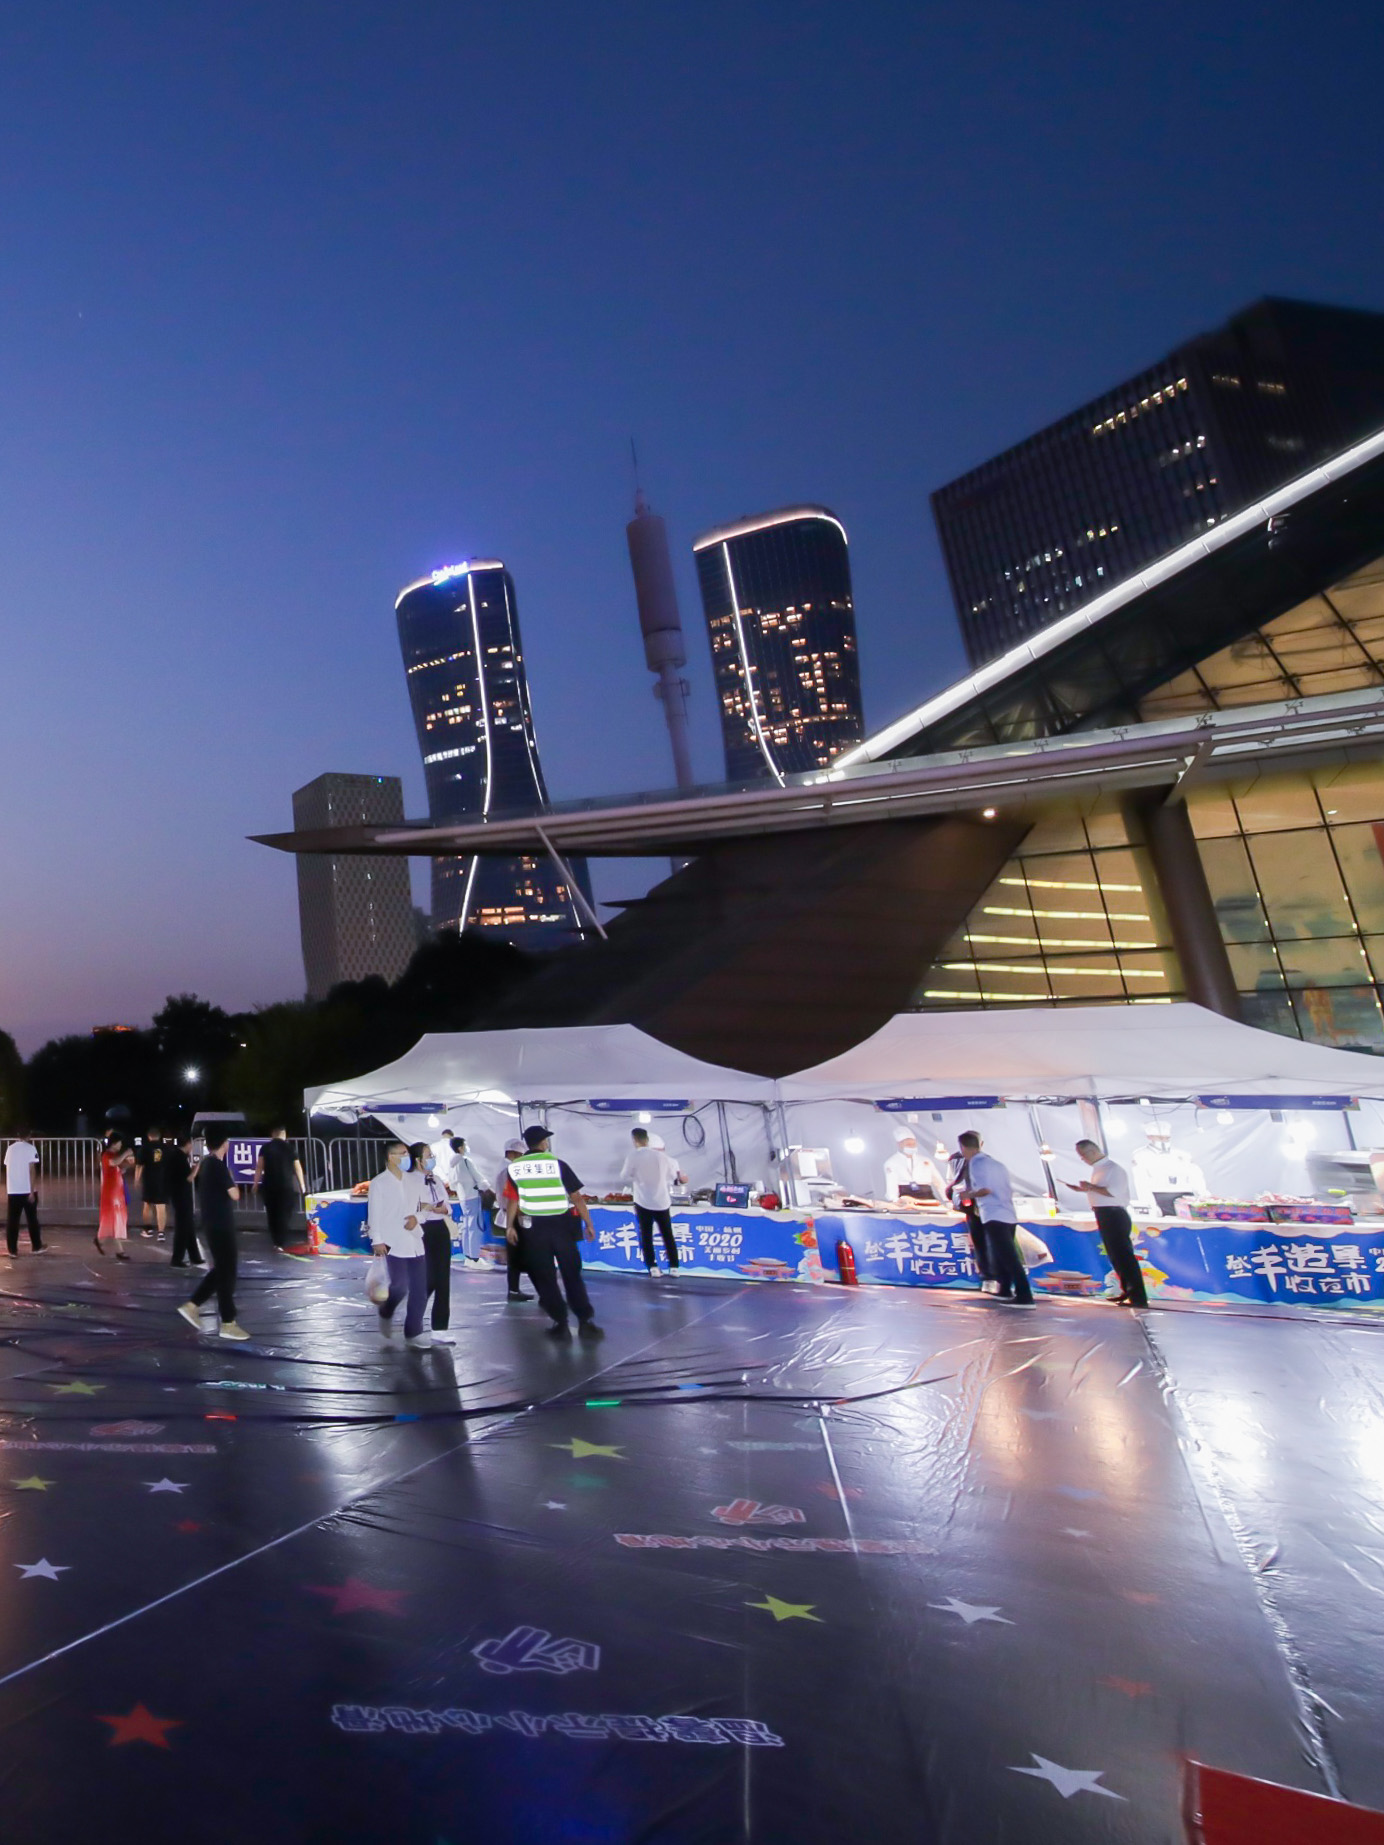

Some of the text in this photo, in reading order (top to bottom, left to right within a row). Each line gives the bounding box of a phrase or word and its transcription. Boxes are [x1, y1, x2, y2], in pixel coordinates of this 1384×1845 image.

[234, 1143, 262, 1165] 出
[513, 1163, 556, 1176] 安保集团
[698, 1233, 743, 1247] 2020
